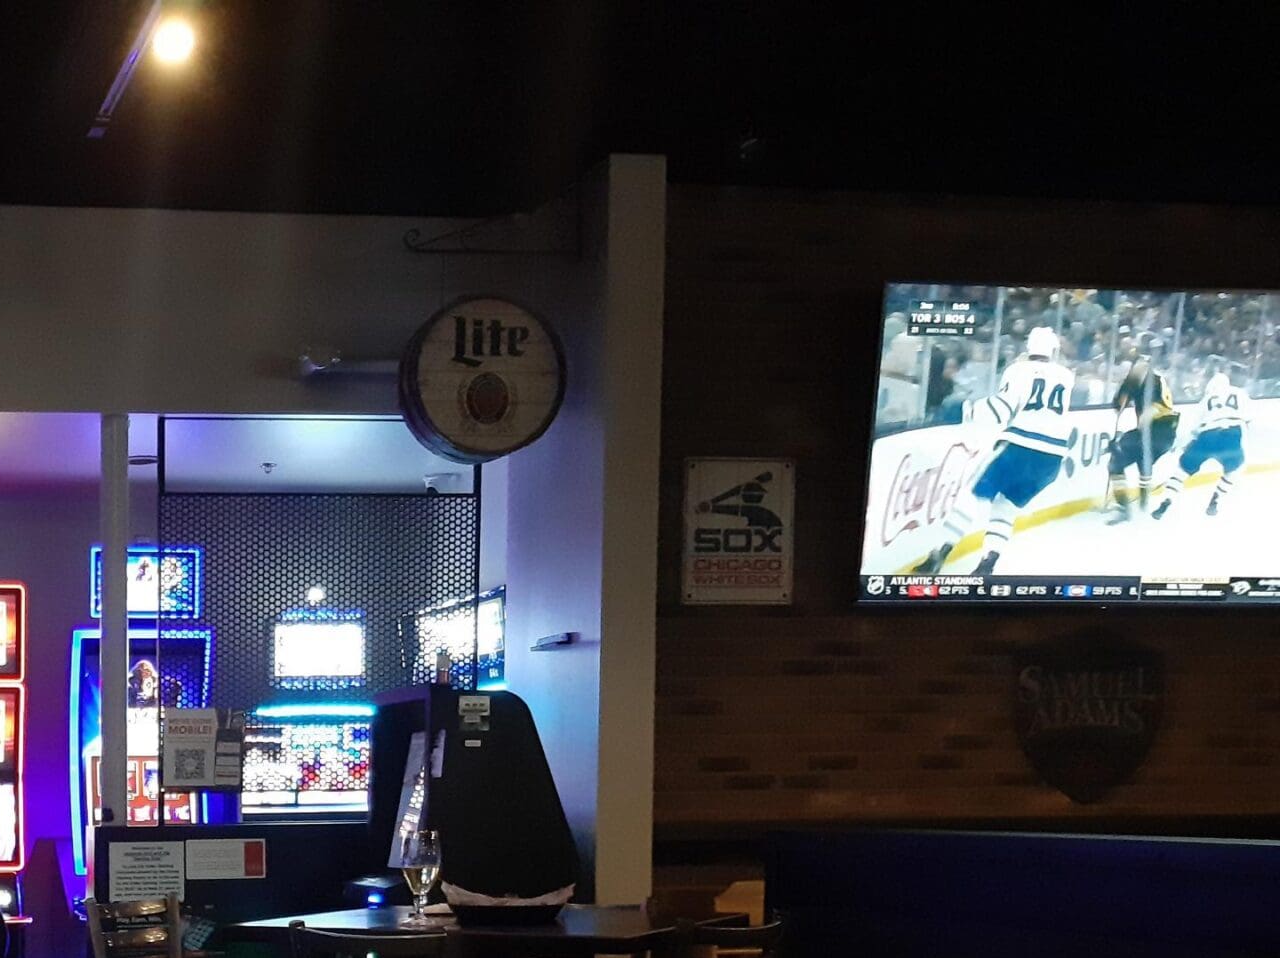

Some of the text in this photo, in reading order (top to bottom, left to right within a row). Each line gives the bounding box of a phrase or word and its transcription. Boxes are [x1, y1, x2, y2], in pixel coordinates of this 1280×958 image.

[911, 313, 975, 324] TOR 3 BOS 4
[451, 316, 529, 367] Lite
[694, 528, 782, 552] SOX
[694, 559, 782, 570] CHICAGO
[890, 577, 984, 586] ATLANTIC STANDINGS
[1025, 698, 1145, 738] ADAMS
[168, 726, 212, 734] MOBILE!
